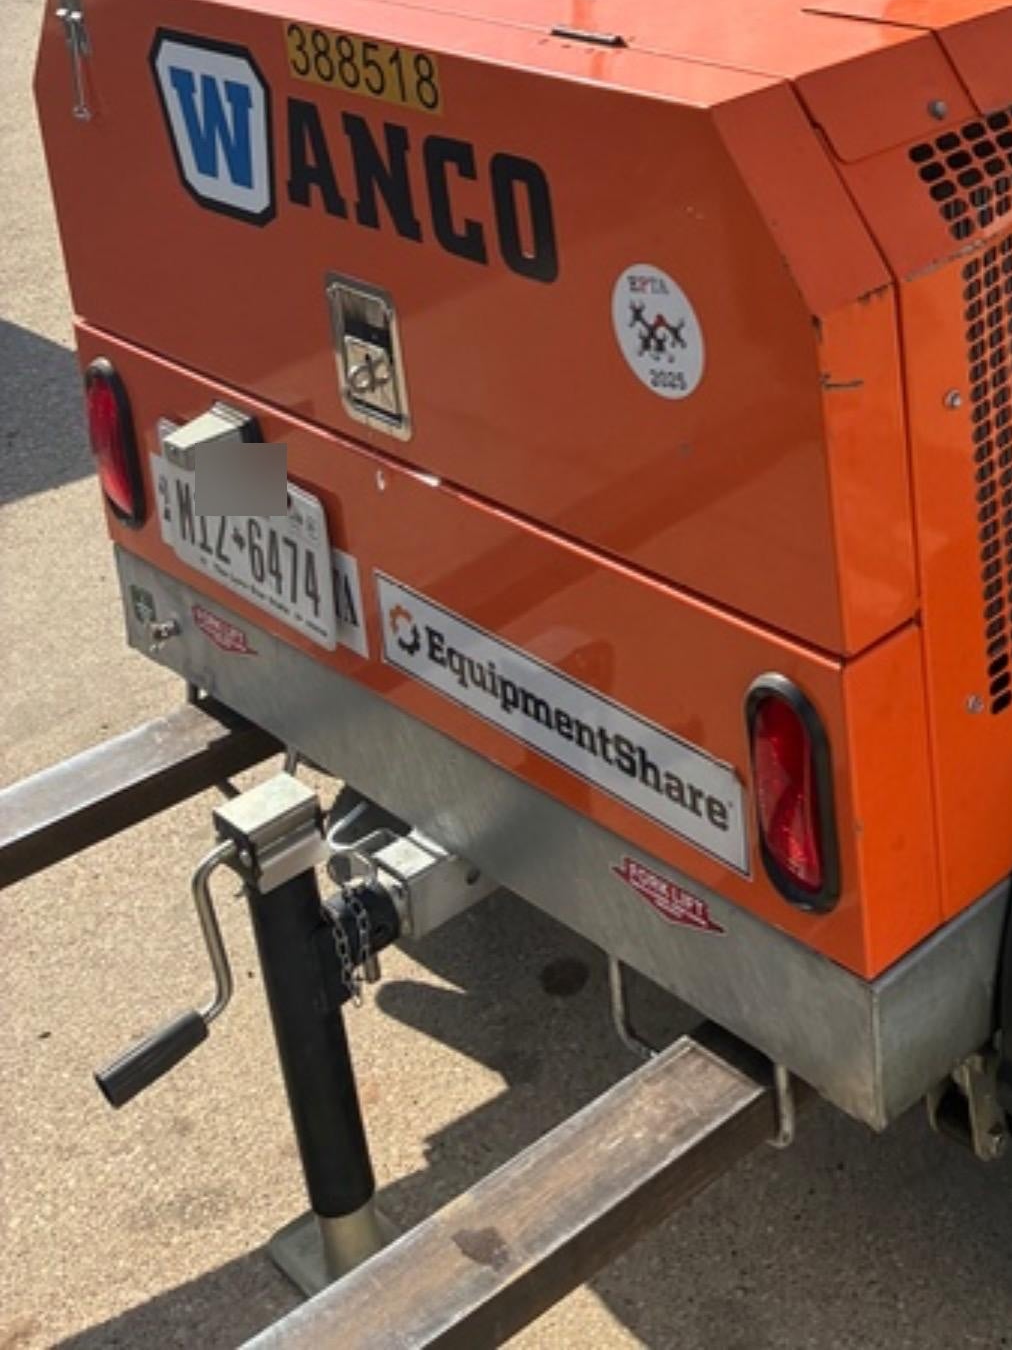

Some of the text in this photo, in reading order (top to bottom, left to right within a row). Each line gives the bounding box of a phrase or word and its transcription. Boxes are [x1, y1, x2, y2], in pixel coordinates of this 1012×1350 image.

[287, 23, 440, 110] 388518
[167, 64, 559, 285] WANCO
[424, 624, 729, 831] EquipmentShare
